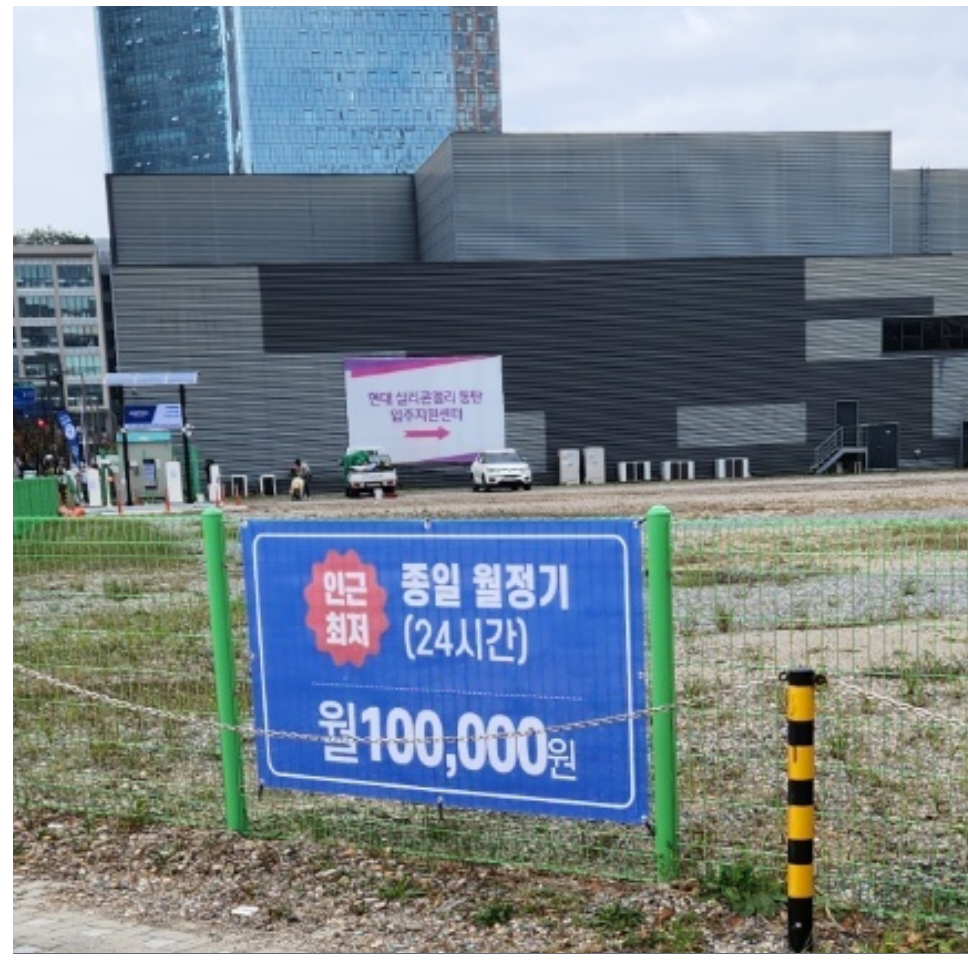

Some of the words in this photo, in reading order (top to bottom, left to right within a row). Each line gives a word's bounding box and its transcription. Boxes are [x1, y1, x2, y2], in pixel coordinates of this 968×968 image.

[390, 407, 463, 423] 입주지원센터
[459, 389, 484, 405] 동탄
[323, 571, 368, 607] 인근
[401, 563, 461, 609] 종일
[473, 563, 570, 610] 월정기
[324, 612, 370, 648] 최저
[403, 613, 528, 665] (24시간)
